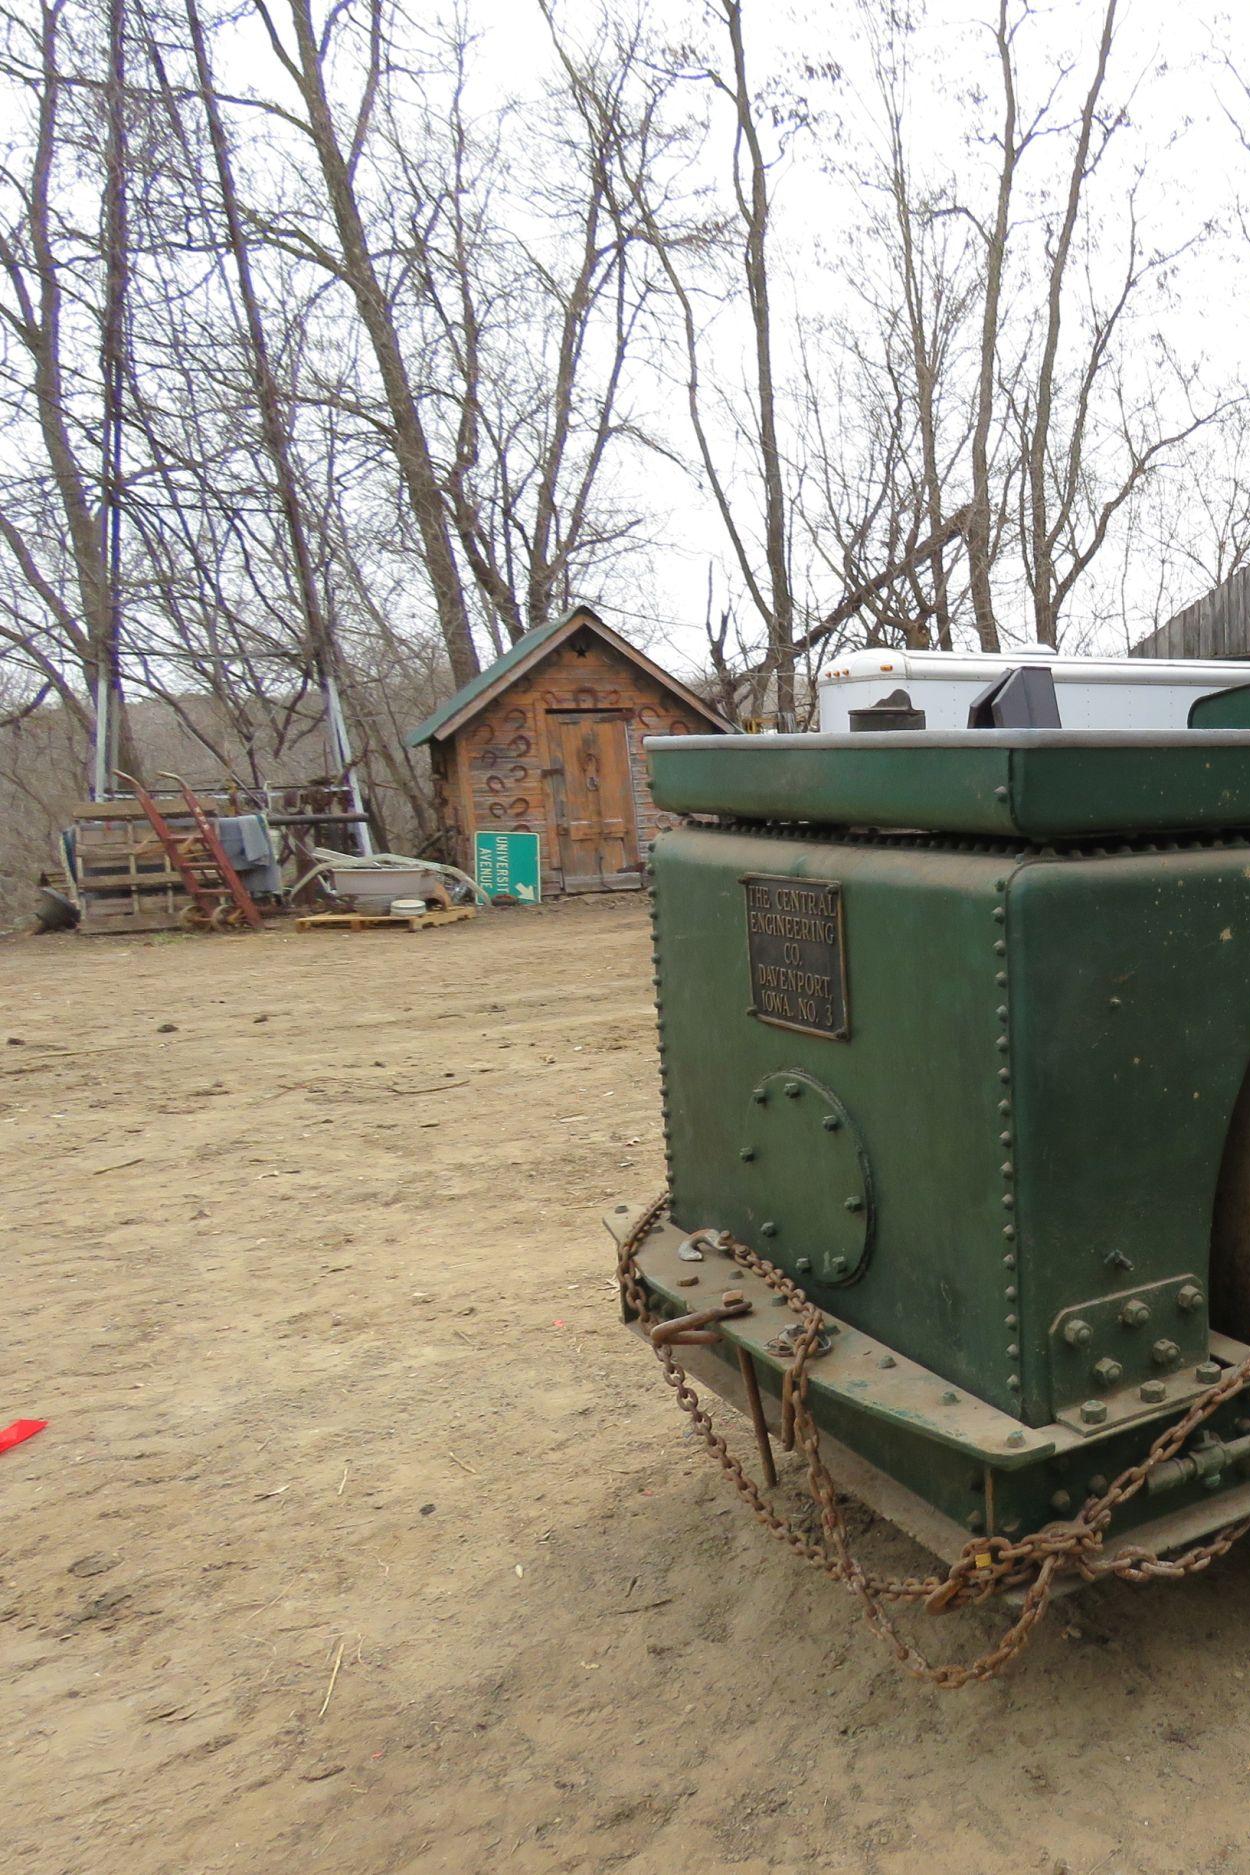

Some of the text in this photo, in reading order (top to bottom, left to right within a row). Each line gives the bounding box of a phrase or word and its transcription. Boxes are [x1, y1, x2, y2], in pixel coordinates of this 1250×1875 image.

[479, 848, 492, 888] AVENUE
[496, 837, 509, 893] UNIVERSIT
[749, 886, 836, 916] THE CENTRAL
[750, 912, 834, 944] ENGINEERING
[759, 964, 833, 1004] DAVENPORT,
[799, 998, 819, 1023] NO.
[824, 1005, 832, 1026] 3
